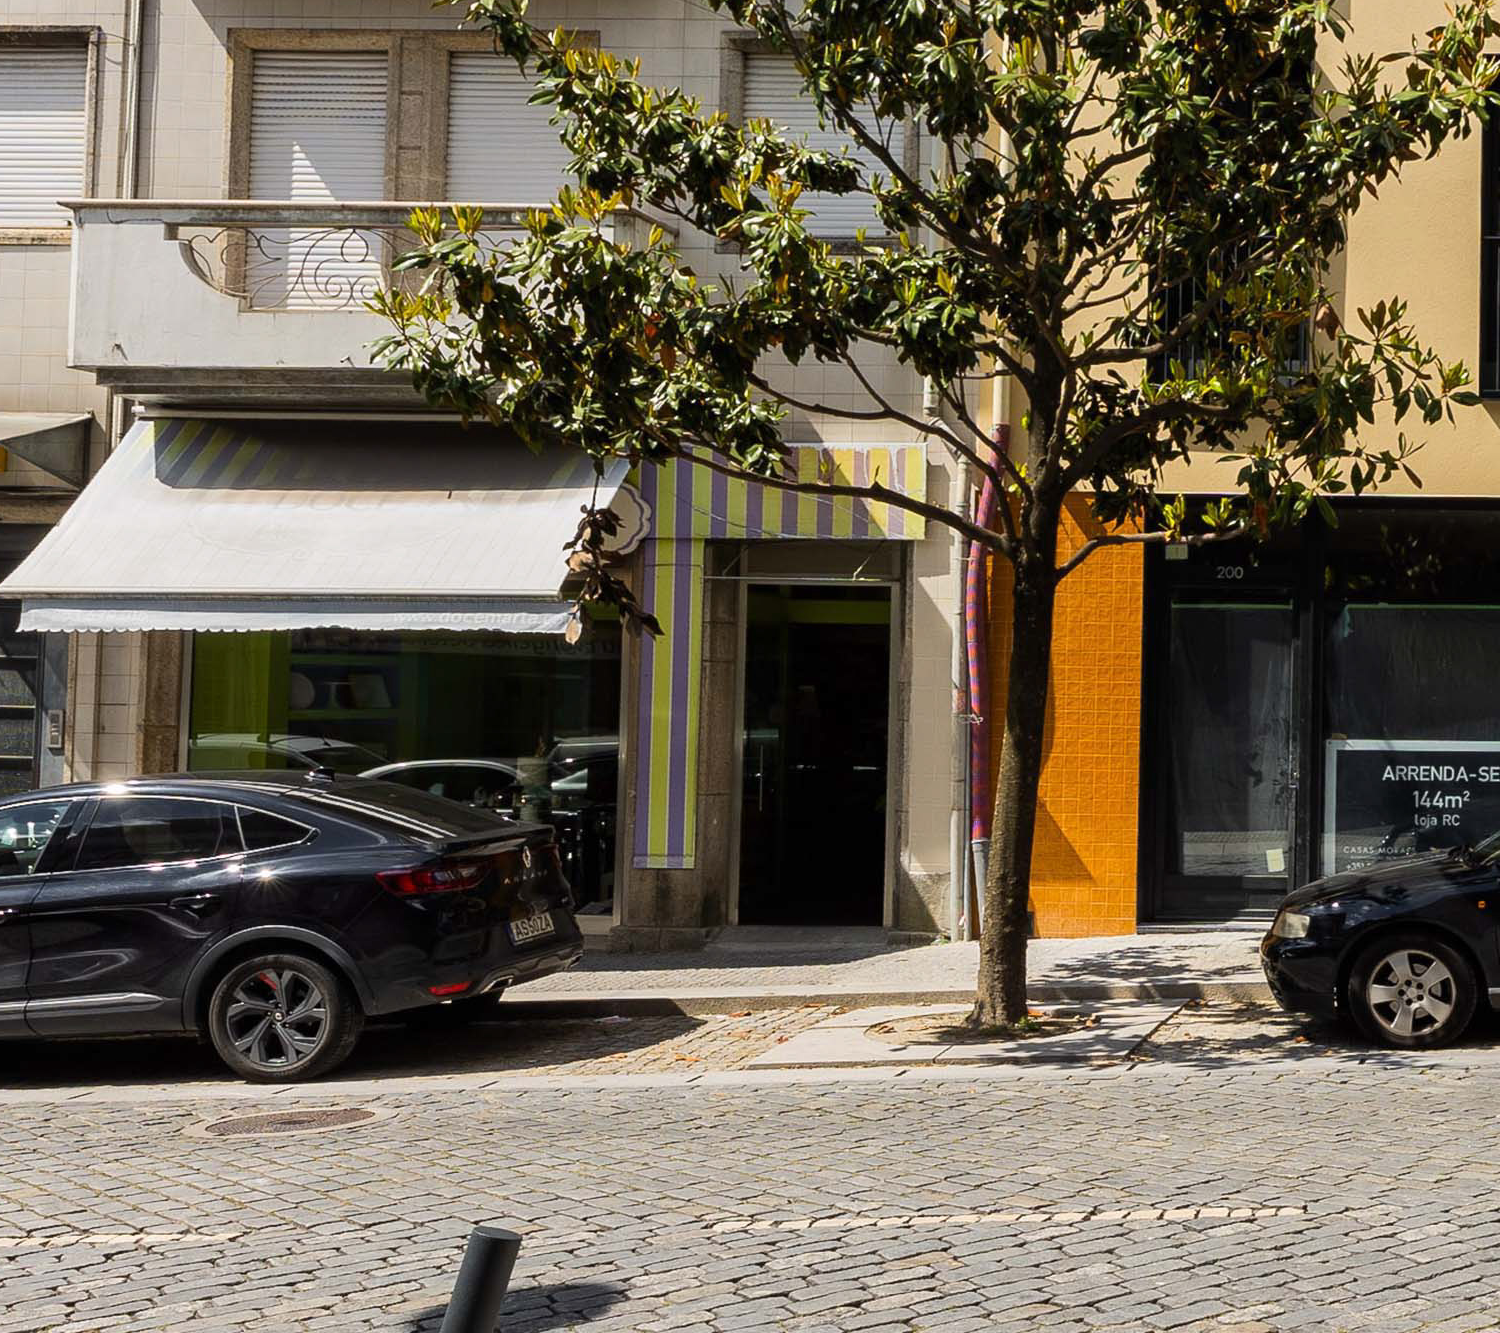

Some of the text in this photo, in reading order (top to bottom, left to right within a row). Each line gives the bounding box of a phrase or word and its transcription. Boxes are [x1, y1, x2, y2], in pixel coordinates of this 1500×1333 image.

[1216, 565, 1244, 579] 200
[1382, 765, 1500, 783] ARRENDA-SE
[1414, 814, 1461, 829] loja RC
[1343, 845, 1374, 854] CASAS
